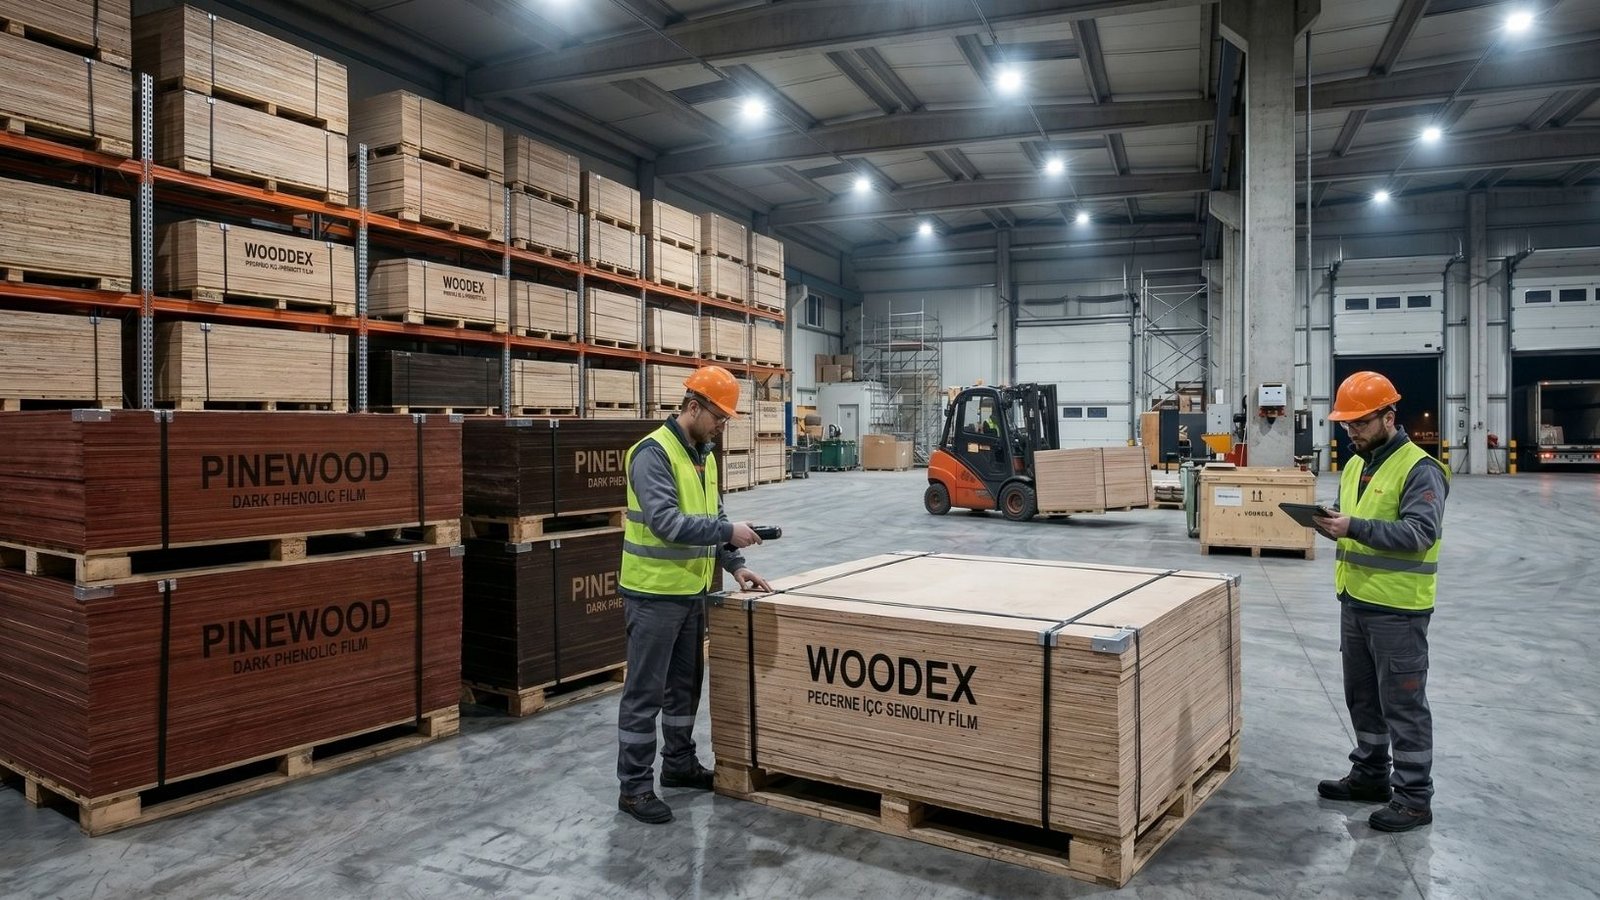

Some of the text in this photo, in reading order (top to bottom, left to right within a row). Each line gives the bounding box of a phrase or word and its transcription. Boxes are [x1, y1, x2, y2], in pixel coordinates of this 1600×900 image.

[244, 242, 313, 267] WOODDEX
[442, 275, 485, 294] WOODEX
[202, 451, 389, 490] PINEWOOD
[588, 477, 608, 488] DARK
[232, 488, 366, 509] DARK PHENOLIC FILM
[572, 570, 620, 602] PINE
[586, 597, 625, 615] DARK PHE
[202, 598, 391, 658] PINEWOOD
[233, 637, 368, 675] DARK PHENOLIC FILM
[806, 644, 978, 706] WOODEX
[808, 689, 978, 730] PECERNE İÇC SENOLITY FİLM
